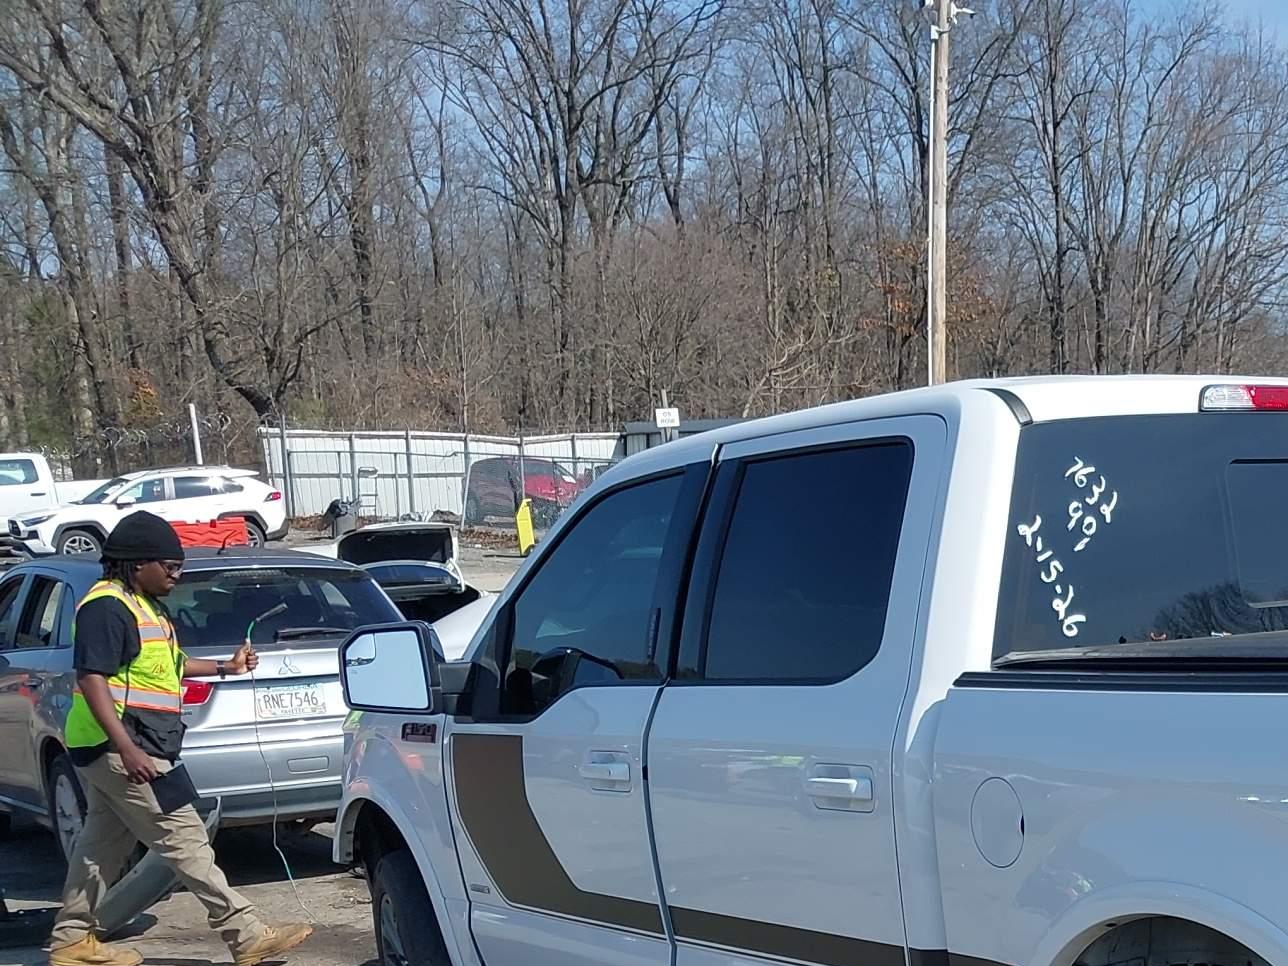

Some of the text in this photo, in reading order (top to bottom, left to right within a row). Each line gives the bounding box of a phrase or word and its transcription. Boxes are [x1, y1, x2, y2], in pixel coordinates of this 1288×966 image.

[1065, 456, 1118, 523] 7632
[1017, 514, 1087, 637] 2-15-26
[263, 690, 319, 709] RNE7546
